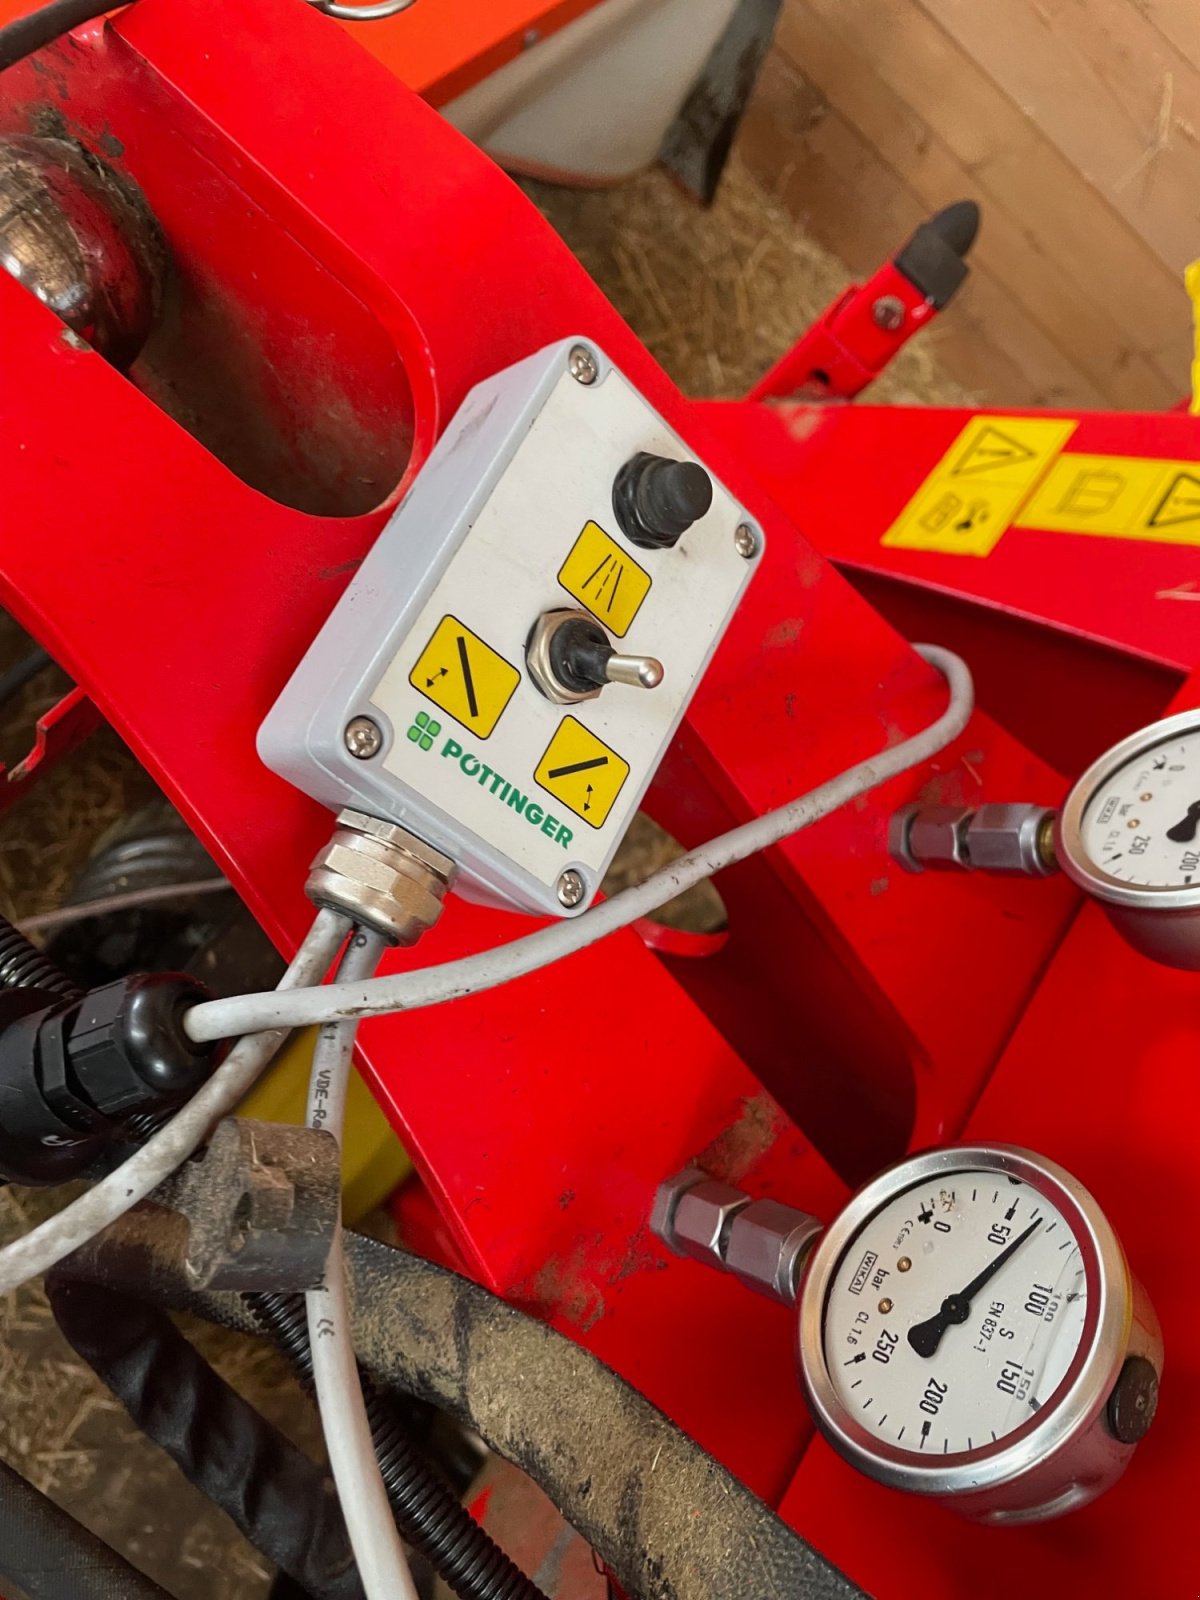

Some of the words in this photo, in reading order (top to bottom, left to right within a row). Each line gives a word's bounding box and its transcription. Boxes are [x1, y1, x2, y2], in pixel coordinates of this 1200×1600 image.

[1129, 835, 1151, 855] 250
[1179, 851, 1200, 871] 200
[934, 1222, 951, 1233] 0
[988, 1223, 1011, 1246] 50
[852, 1255, 874, 1291] WIKA
[873, 1268, 890, 1291] bar
[990, 1301, 1005, 1319] EN
[1024, 1283, 1053, 1316] 100
[858, 1311, 869, 1326] CL
[847, 1328, 863, 1345] 1.6
[974, 1319, 997, 1353] 837-1
[999, 1327, 1014, 1340] S
[872, 1330, 899, 1365] 250
[997, 1361, 1023, 1395] 150
[919, 1377, 948, 1416] 200
